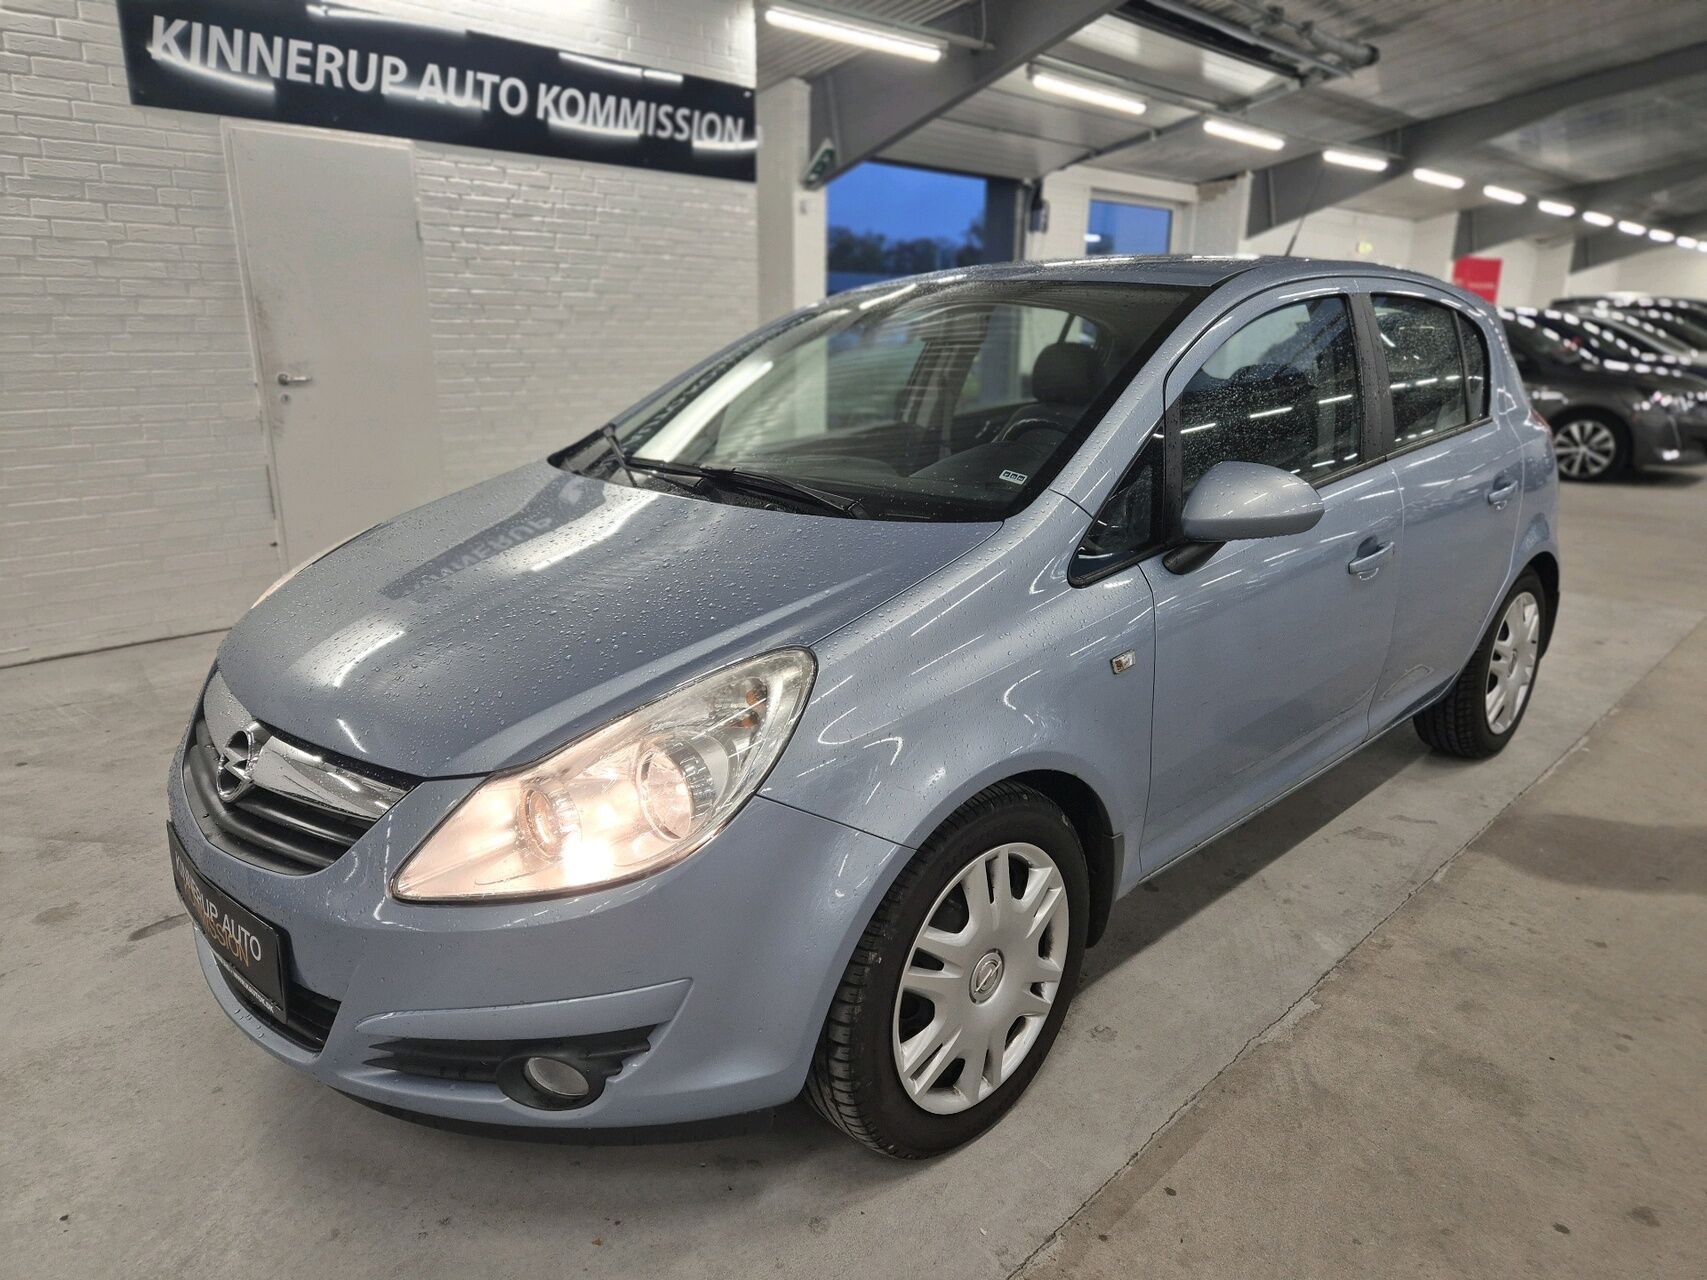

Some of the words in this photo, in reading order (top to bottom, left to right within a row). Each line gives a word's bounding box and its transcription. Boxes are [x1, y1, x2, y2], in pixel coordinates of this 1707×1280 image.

[152, 15, 408, 95] KINNERUP
[416, 63, 528, 116] AUTO
[536, 83, 745, 144] KOMMISSION
[184, 880, 250, 967] ISSION
[222, 914, 261, 961] AUTO
